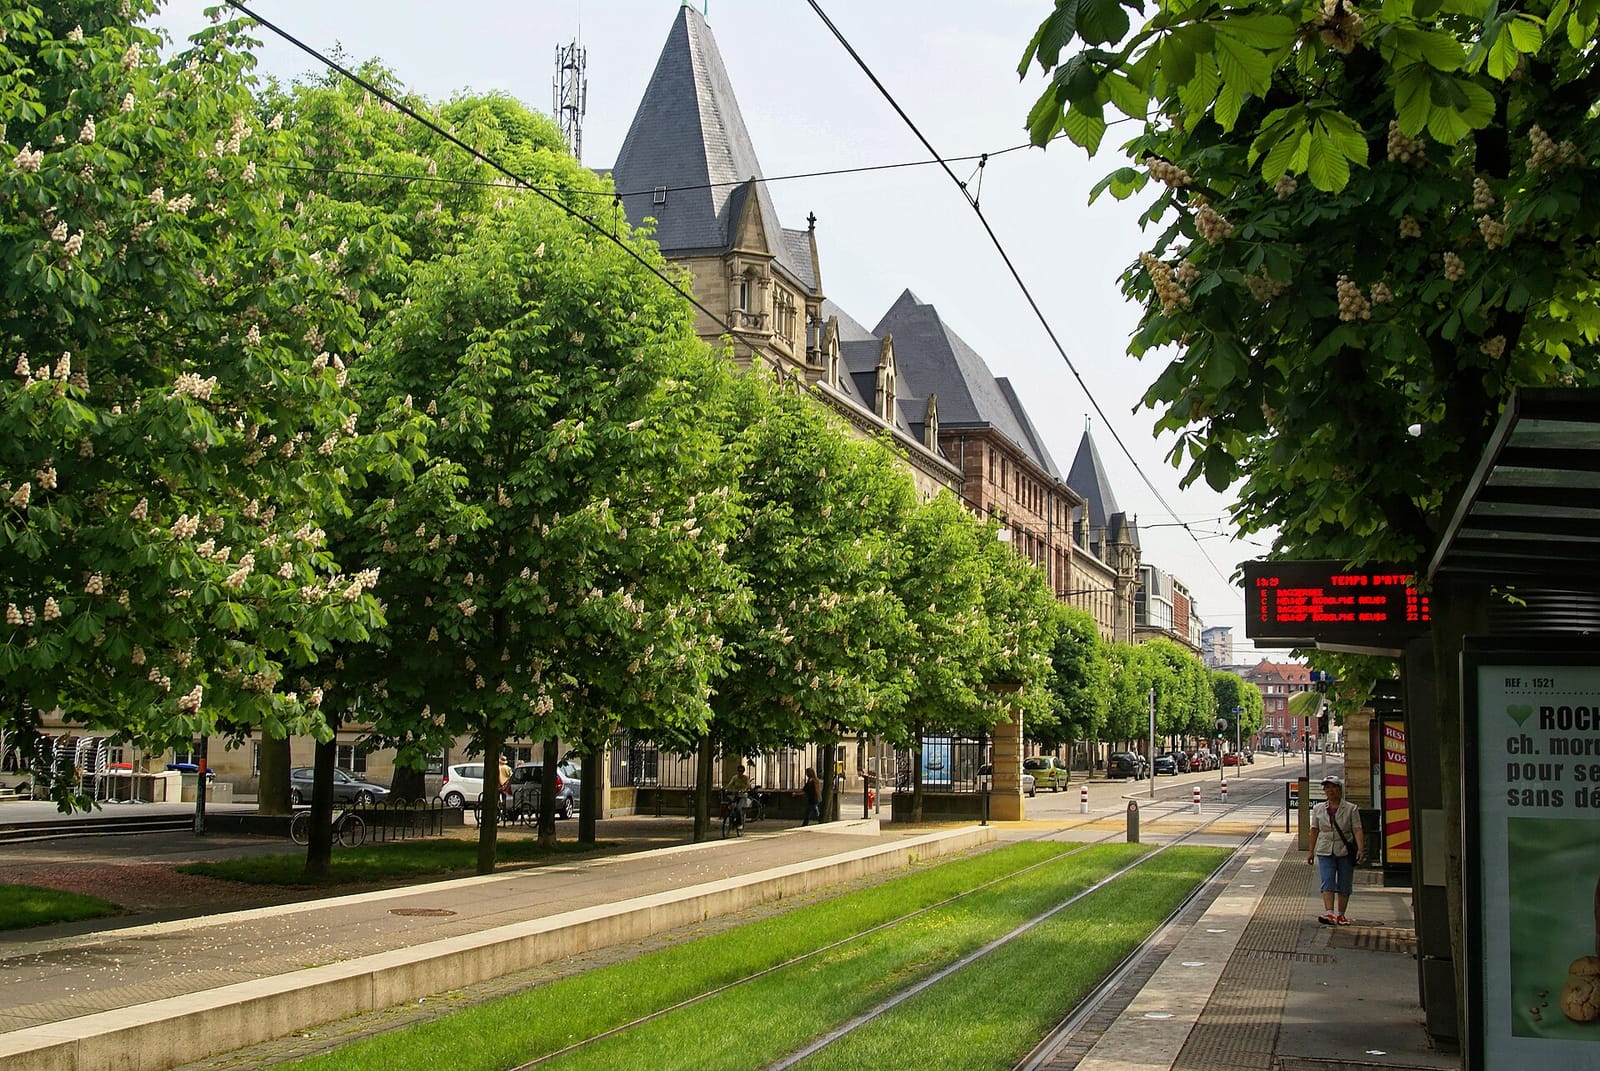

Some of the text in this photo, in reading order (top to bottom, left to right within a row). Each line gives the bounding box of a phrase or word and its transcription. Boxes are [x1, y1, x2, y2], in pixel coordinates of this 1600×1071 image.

[1330, 575, 1368, 586] TEMPS
[1406, 613, 1418, 621] 22
[1504, 678, 1521, 688] REF
[1532, 678, 1555, 689] 1521
[1506, 733, 1540, 755] ch.
[1387, 751, 1407, 763] VOS
[1506, 762, 1564, 783] pour
[1507, 788, 1564, 807] sans
